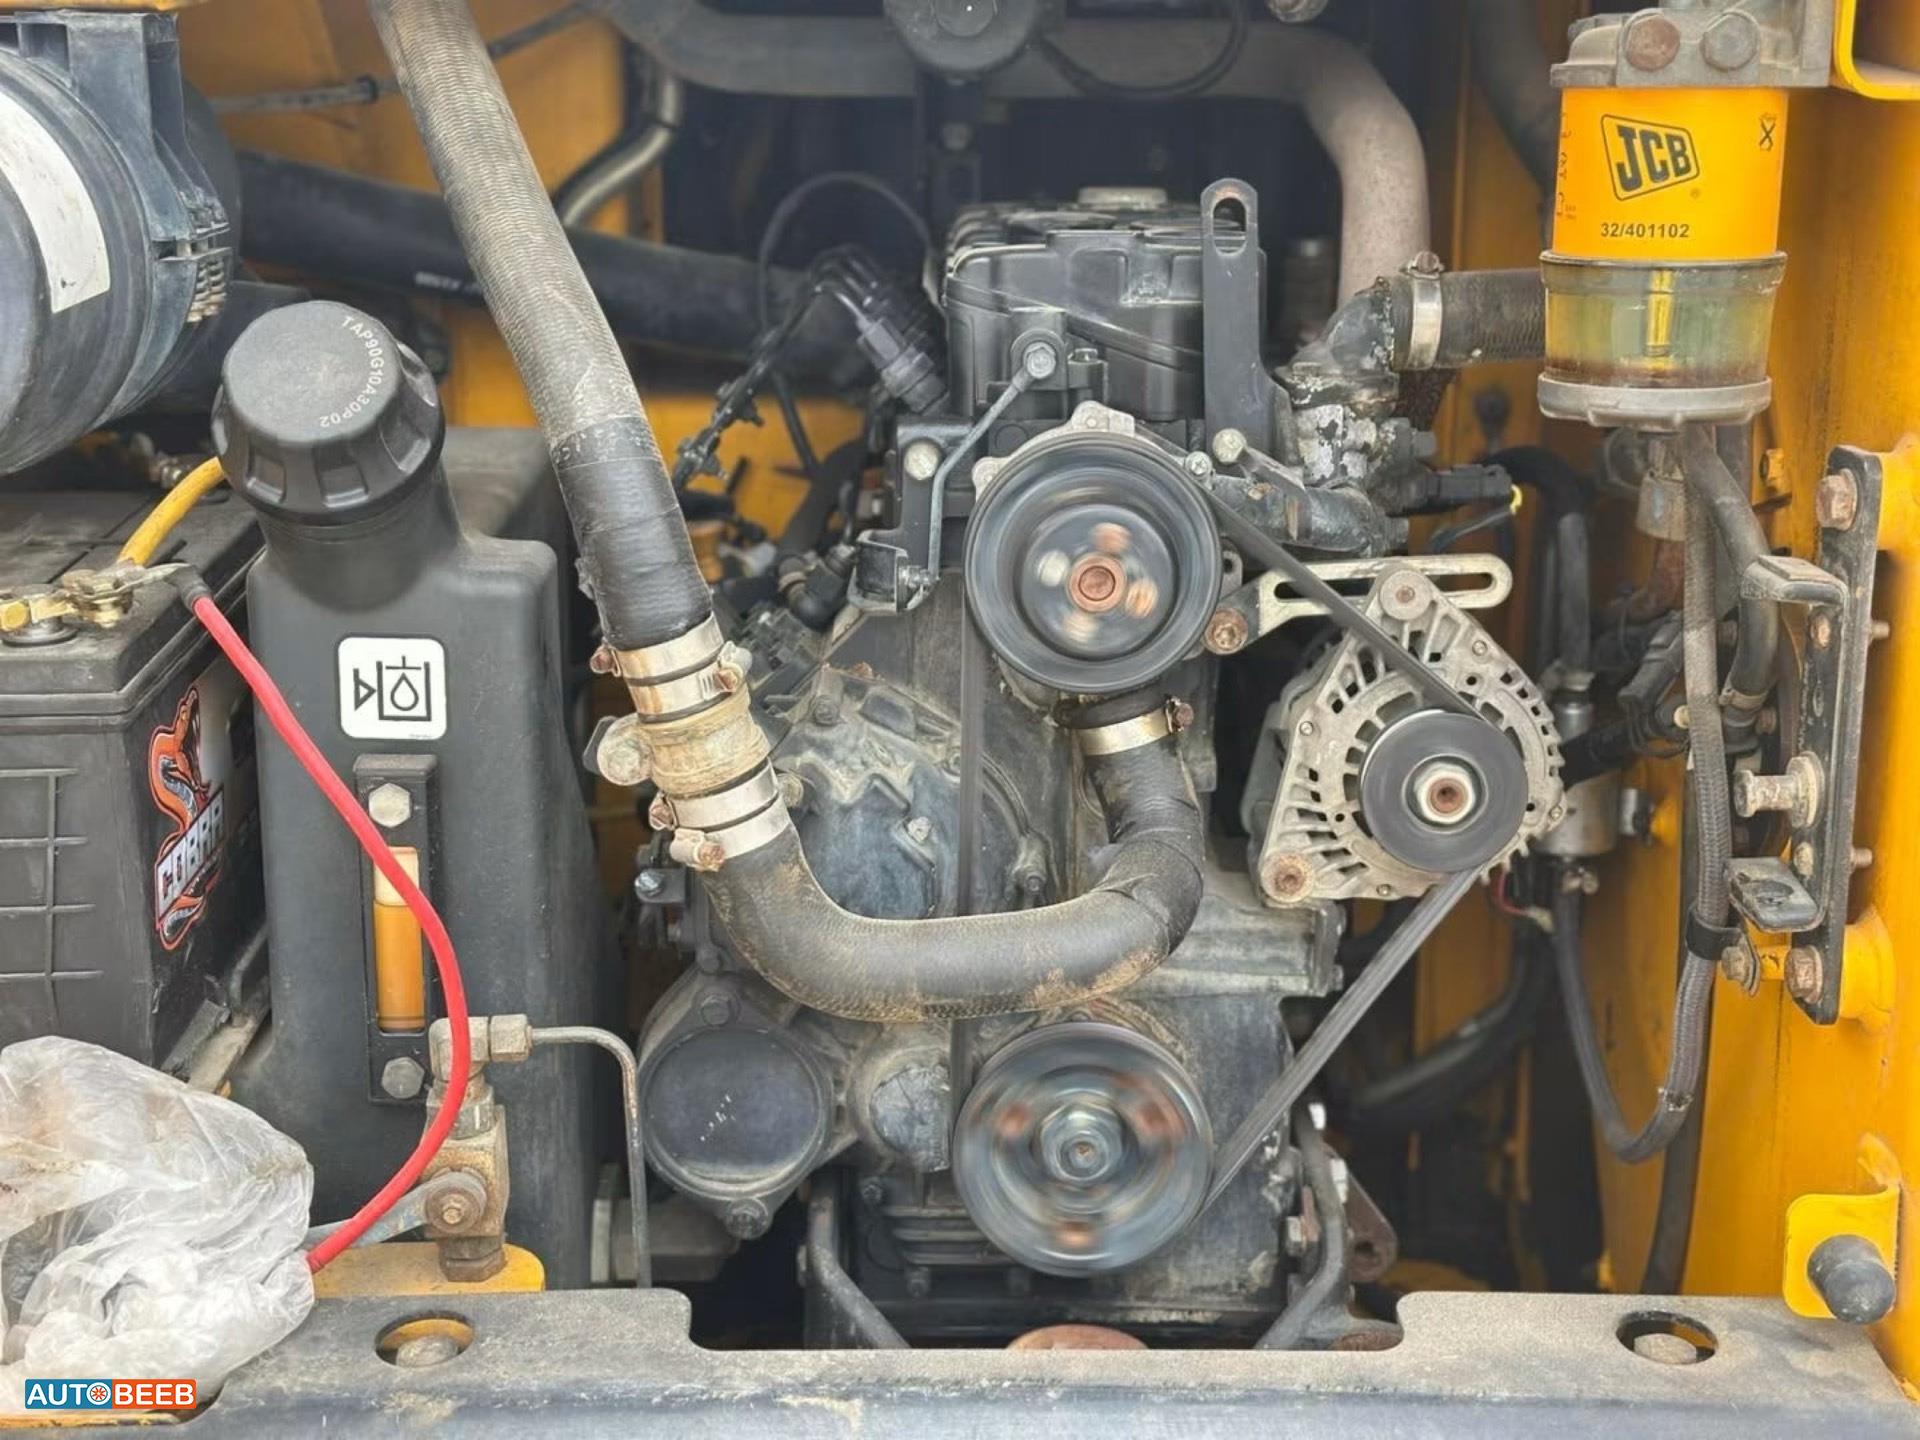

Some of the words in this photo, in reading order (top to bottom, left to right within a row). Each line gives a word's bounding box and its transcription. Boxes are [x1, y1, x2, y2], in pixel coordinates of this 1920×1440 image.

[1616, 125, 1691, 192] JCB
[1600, 222, 1690, 238] 32/401102
[157, 790, 224, 921] COBRA
